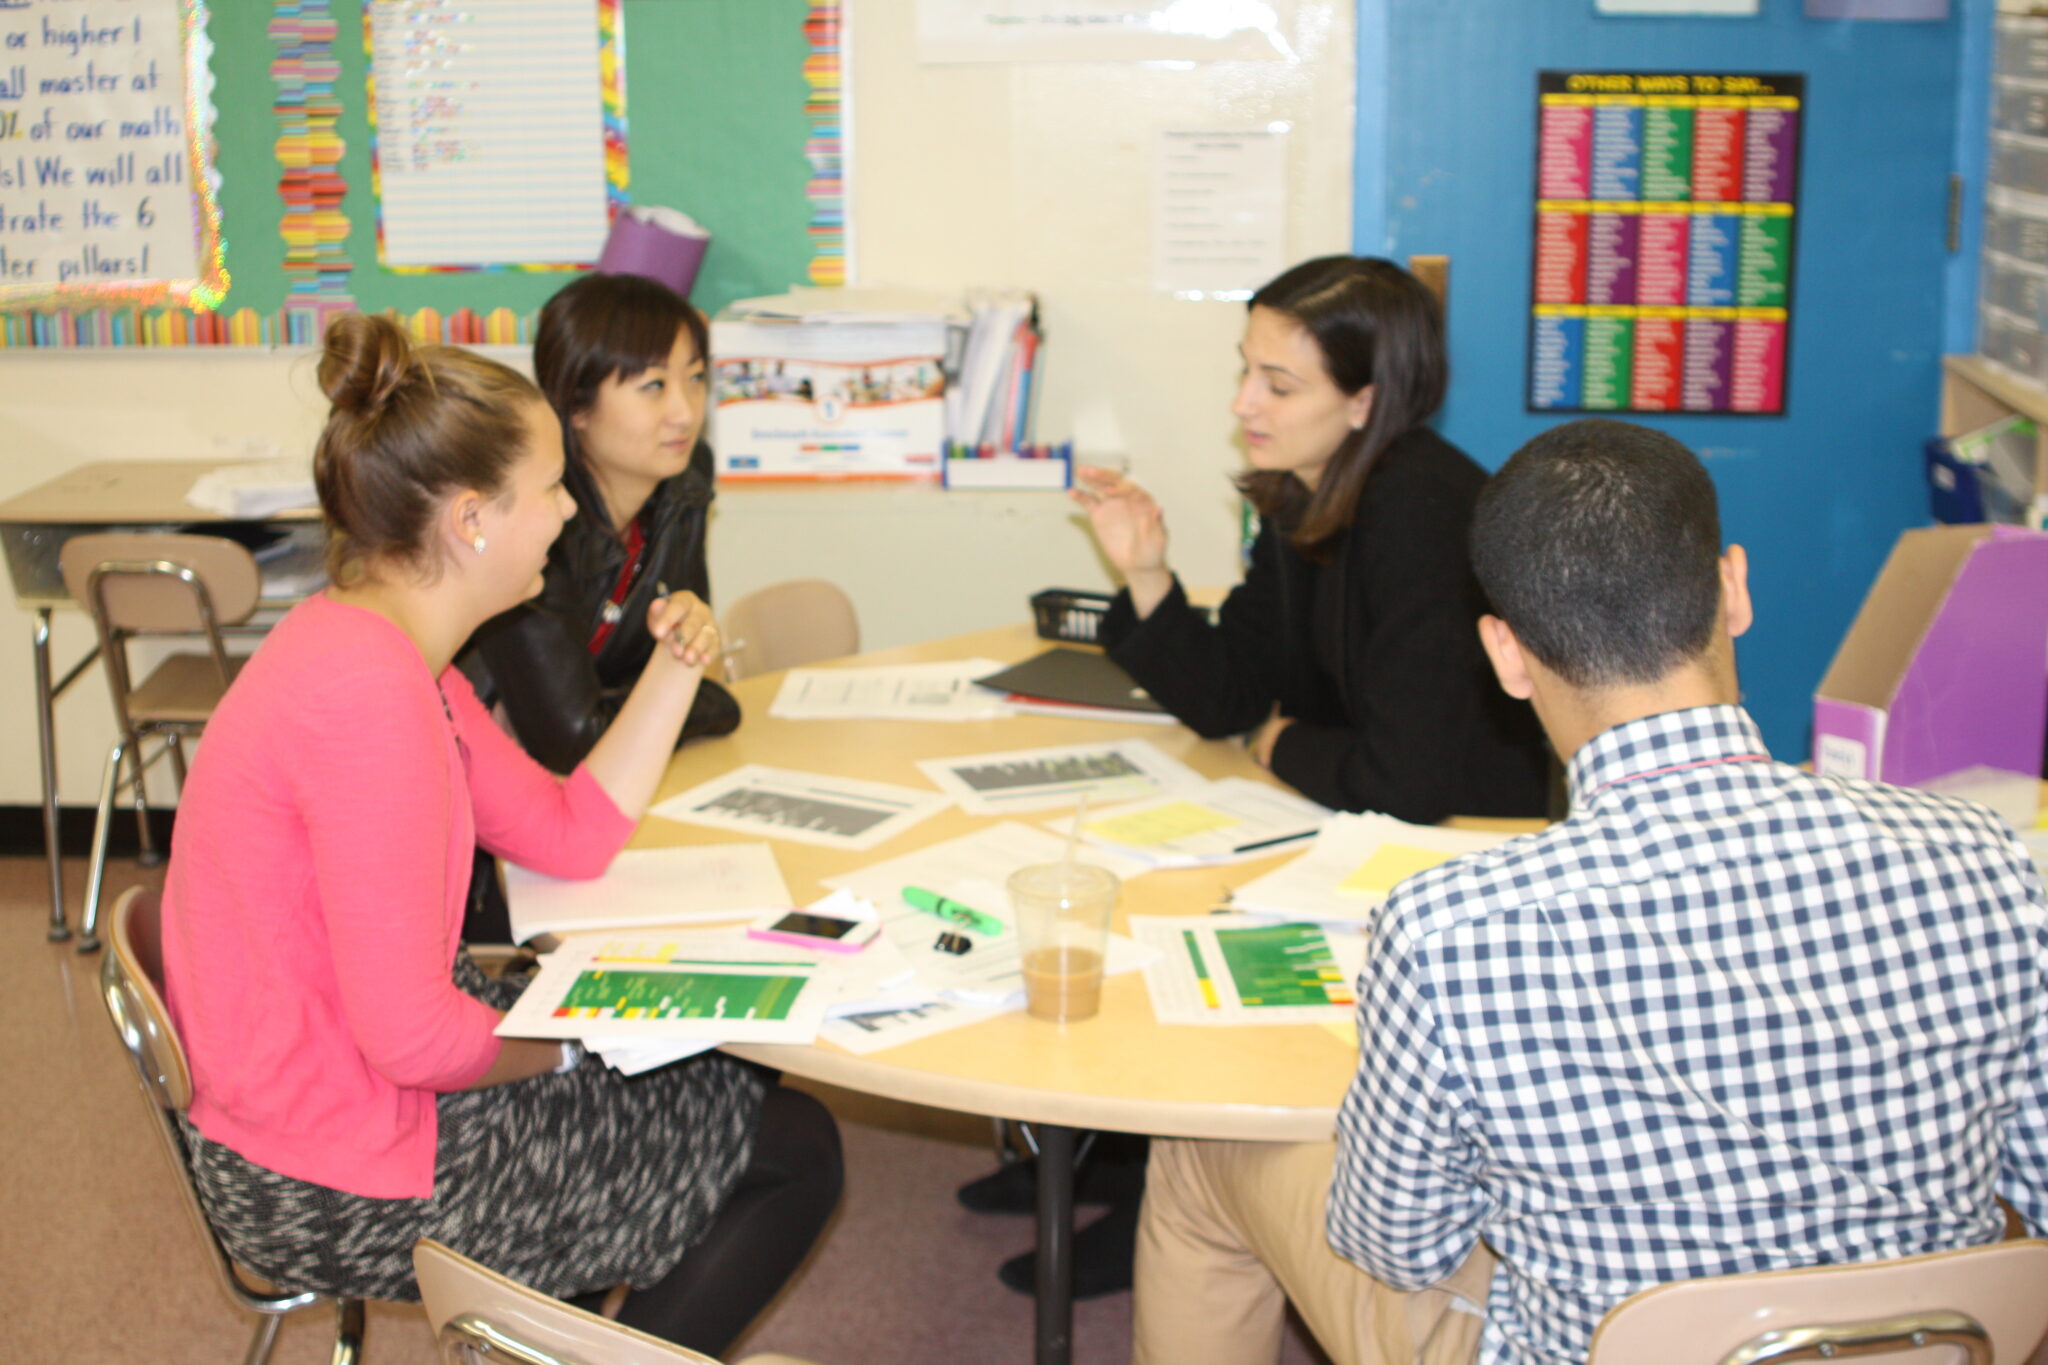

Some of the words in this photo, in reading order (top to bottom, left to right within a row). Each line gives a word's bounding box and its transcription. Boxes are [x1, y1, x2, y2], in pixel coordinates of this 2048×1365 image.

[5, 31, 27, 49] or
[39, 60, 122, 93] master
[131, 60, 161, 92] at
[1566, 75, 1634, 93] OTHER
[1634, 75, 1690, 93] WAYS
[1691, 76, 1721, 93] TO
[30, 106, 57, 140] of
[65, 119, 107, 139] our
[119, 105, 180, 138] math
[34, 154, 74, 187] We
[86, 151, 135, 187] will
[145, 151, 183, 184] all
[83, 199, 119, 229] the
[137, 196, 156, 229] 6
